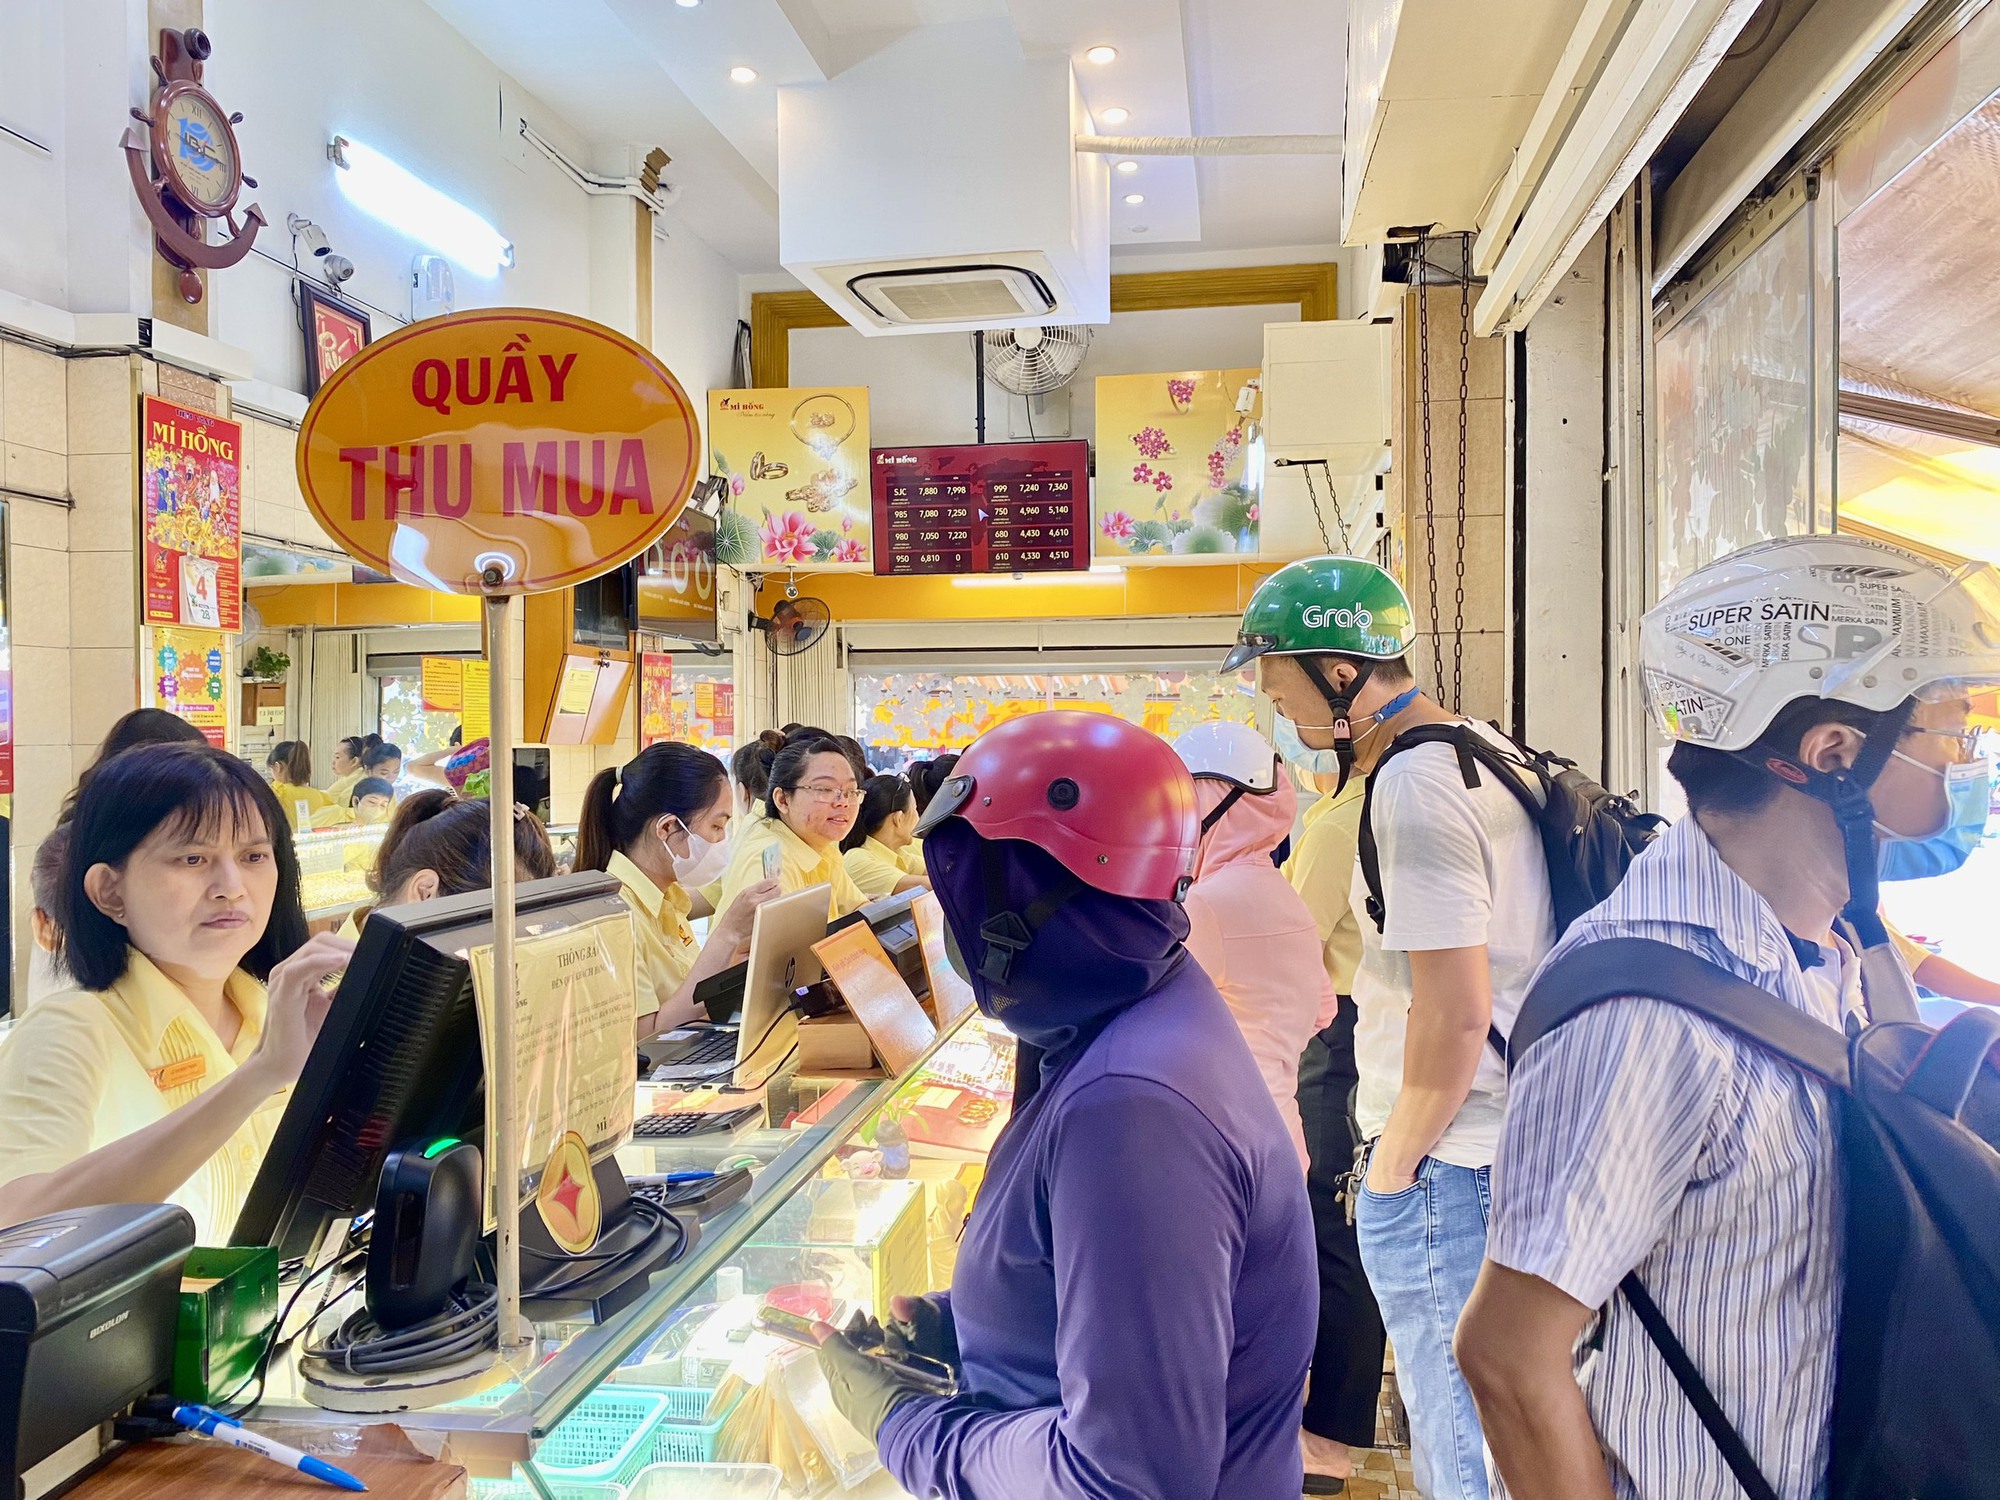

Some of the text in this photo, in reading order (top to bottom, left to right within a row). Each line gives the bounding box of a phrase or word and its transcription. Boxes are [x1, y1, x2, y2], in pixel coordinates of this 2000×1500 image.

[412, 333, 578, 416] QUẦY
[339, 438, 655, 522] THU MUA
[894, 486, 966, 497] SJC 7,880 7,998
[993, 482, 1069, 493] 999 7,240 7,360
[894, 508, 967, 519] 985 7,080 7,250
[994, 505, 1069, 516] 750 4,960 5,140
[895, 531, 968, 541] 980 7,050 7,220
[994, 528, 1069, 539] 680 4,430 4,610
[895, 553, 961, 564] 950 6,810 0
[995, 550, 1070, 561] 610 4,330 4,510
[196, 576, 207, 600] 4
[1860, 582, 1888, 591] SUPER
[1302, 601, 1373, 629] Grab
[1688, 603, 1830, 631] SUPER SATIN
[1831, 615, 1888, 626] MERKA SATIN
[1763, 622, 1772, 641] SATIN
[1782, 621, 1792, 641] SATIN
[1724, 635, 1752, 646] ONE
[557, 948, 586, 969] THÔNG
[89, 1310, 131, 1340] BIXOLON
